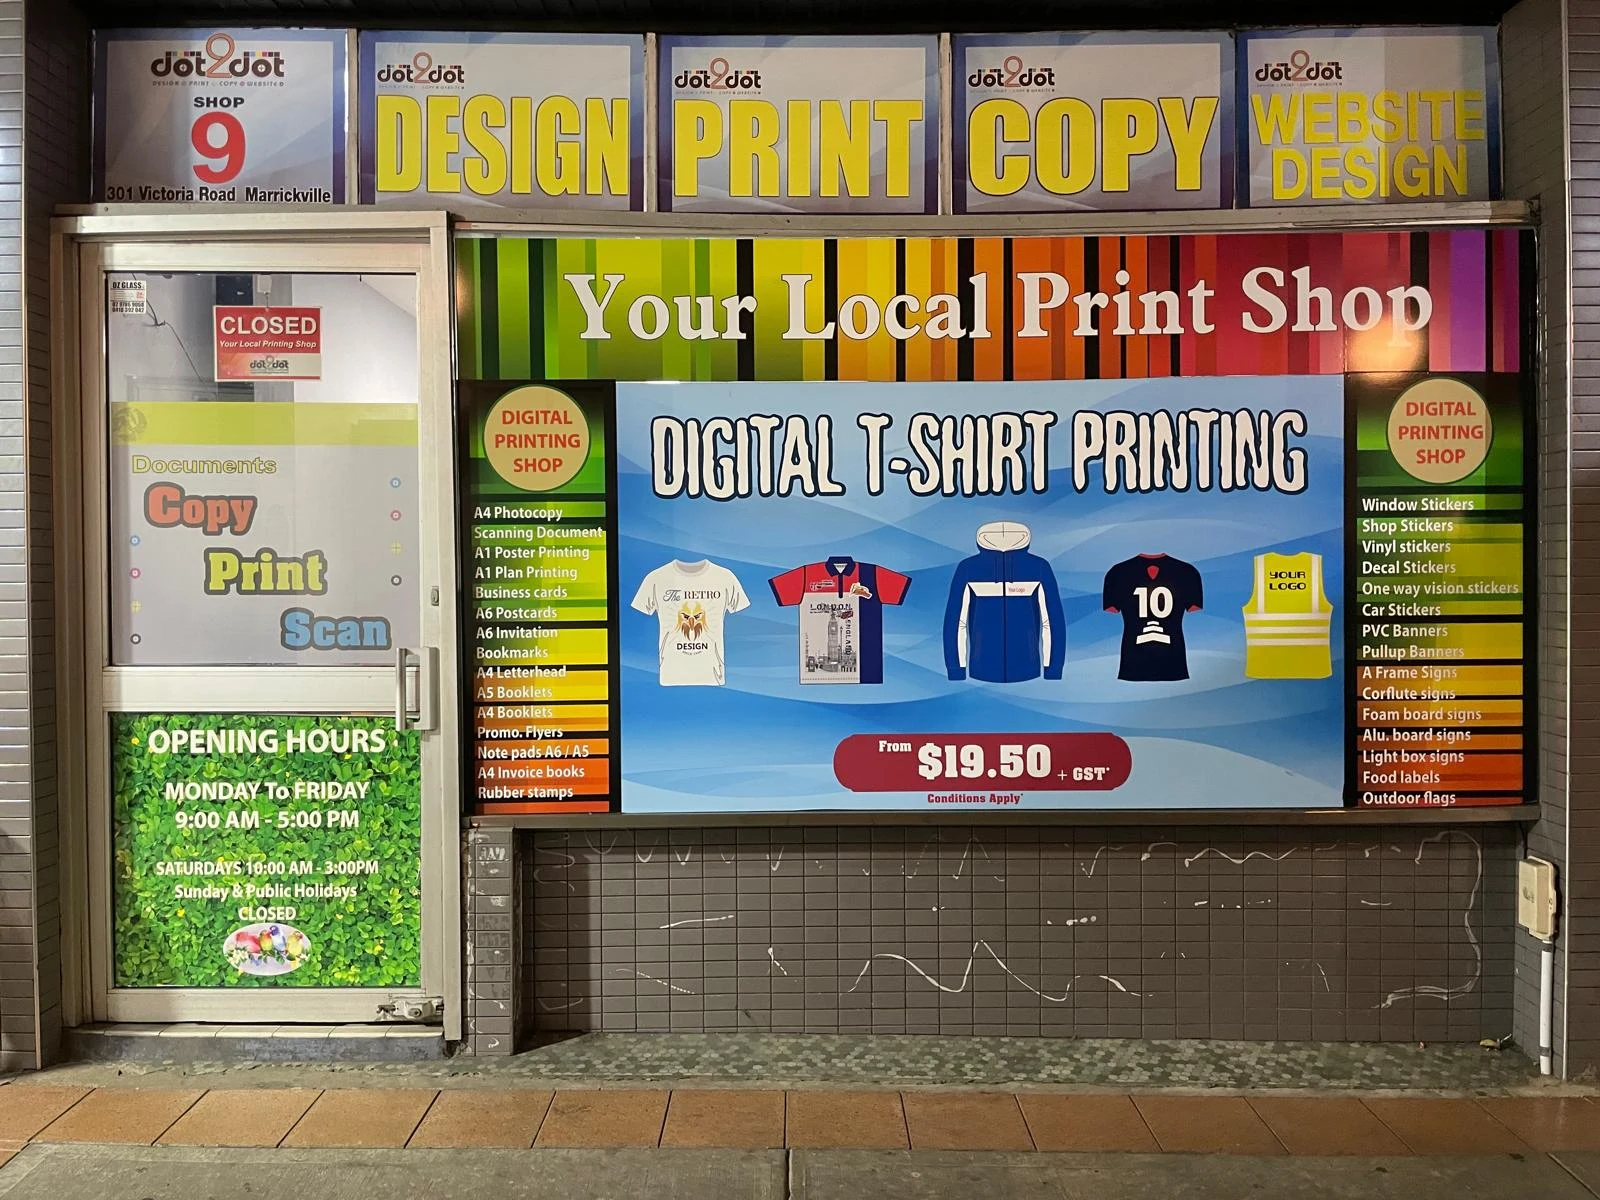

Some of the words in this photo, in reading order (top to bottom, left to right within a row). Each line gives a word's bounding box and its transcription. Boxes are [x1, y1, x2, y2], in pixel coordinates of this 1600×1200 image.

[151, 33, 285, 78] dot2dot
[377, 52, 464, 83] dot2dot
[674, 57, 761, 89] dot2dot
[968, 56, 1055, 87] dot2dot
[1255, 50, 1342, 81] dot2dot
[193, 96, 245, 109] SHOP
[1250, 89, 1485, 145] WEBSITE
[191, 111, 246, 184] 9
[376, 94, 629, 195] DESIGN
[674, 99, 923, 198] PRINT
[968, 97, 1219, 196] COPY
[1272, 143, 1468, 200] DESIGN
[107, 187, 132, 201] 301
[139, 186, 194, 201] Victoria
[199, 187, 236, 202] Road
[245, 187, 332, 203] Marrickville
[563, 273, 758, 341] Your
[780, 272, 992, 341] Local
[1016, 269, 1216, 338] Print
[1241, 265, 1434, 348] Shop
[220, 316, 317, 335] CLOSED
[263, 340, 293, 349] Printing
[296, 341, 316, 349] Shop
[1406, 402, 1476, 416] DIGITAL
[502, 410, 573, 425] DIGITAL
[1398, 425, 1483, 440] PRINTING
[495, 434, 580, 448] PRINTING
[650, 414, 846, 500] DIGITAL
[858, 410, 1057, 497] T-SHIRT
[1072, 408, 1307, 496] PRINTING
[1416, 449, 1465, 464] SHOP
[132, 455, 277, 474] Documents
[513, 458, 563, 473] SHOP
[144, 482, 257, 535] Copy
[1362, 498, 1417, 511] Window
[1421, 498, 1474, 511] Stickers
[474, 507, 491, 519] A4
[494, 506, 562, 521] Photocopy
[474, 527, 533, 541] Scanning
[537, 527, 603, 539] Document
[1362, 519, 1397, 535] Shop
[1401, 519, 1454, 532] Stickers
[475, 547, 490, 559] A1
[495, 547, 535, 559] Poster
[539, 546, 590, 560] Printing
[1362, 540, 1396, 556] Vinyl
[1400, 540, 1451, 553] stickers
[204, 548, 327, 595] Print
[475, 567, 491, 579] A1
[496, 566, 523, 579] Plan
[527, 566, 578, 580] Printing
[1269, 571, 1306, 579] YOUR
[1362, 561, 1399, 574] Decal
[1403, 561, 1456, 574] Stickers
[476, 587, 530, 599] Business
[534, 586, 567, 598] cards
[1269, 582, 1306, 591] LOGO
[1362, 582, 1390, 595] One
[1394, 584, 1420, 597] way
[1424, 582, 1464, 594] vision
[1468, 581, 1518, 594] stickers
[663, 590, 681, 602] The
[684, 590, 720, 600] RETRO
[1133, 586, 1173, 619] 10
[476, 608, 493, 619] A6
[496, 607, 557, 619] Postcards
[1362, 604, 1384, 617] Car
[1388, 603, 1441, 616] Stickers
[281, 607, 391, 650] Scan
[476, 627, 493, 639] A6
[496, 627, 558, 639] Invitation
[1362, 625, 1389, 637] PVC
[1393, 625, 1448, 637] Banners
[477, 647, 548, 659] Bookmarks
[1362, 645, 1405, 661] Pullup
[1410, 645, 1464, 658] Banners
[477, 667, 493, 678] A4
[497, 666, 567, 678] Letterhead
[1363, 667, 1372, 679] A
[1376, 666, 1417, 679] Frame
[1422, 666, 1457, 681] Signs
[477, 687, 493, 699] A5
[497, 686, 552, 699] Booklets
[1363, 687, 1417, 700] Corflute
[1421, 688, 1456, 702] signs
[477, 706, 494, 718] A4
[497, 706, 553, 718] Booklets
[1363, 708, 1399, 721] Foam
[1404, 707, 1443, 721] board
[1447, 709, 1482, 723] signs
[478, 727, 523, 738] Promo.
[525, 726, 563, 740] Flyers
[1363, 728, 1389, 742] Alu.
[1393, 728, 1433, 741] board
[1436, 730, 1471, 744] signs
[149, 729, 278, 754] OPENING
[287, 729, 387, 754] HOURS
[478, 747, 507, 759] Note
[512, 746, 542, 761] pads
[545, 746, 562, 757] A6
[564, 746, 569, 758] /
[573, 745, 589, 757] A5
[879, 740, 912, 752] From
[918, 742, 1051, 780] $19.50
[1057, 769, 1068, 781] +
[1363, 750, 1398, 766] Light
[1401, 750, 1426, 763] box
[1429, 751, 1464, 765] signs
[478, 767, 494, 779] A4
[498, 766, 543, 778] Invoice
[547, 766, 585, 777] books
[1363, 771, 1396, 784] Food
[1401, 771, 1440, 784] labels
[165, 782, 261, 801] MONDAY
[265, 782, 289, 800] To
[295, 782, 370, 800] FRIDAY
[478, 786, 524, 799] Rubber
[528, 787, 573, 800] stamps
[927, 793, 986, 803] Conditions
[1363, 792, 1420, 805] Outdoor
[1424, 791, 1456, 807] flags
[175, 810, 220, 829] 9:00
[225, 810, 260, 829] AM
[277, 810, 321, 829] 5:00
[327, 810, 359, 828] PM
[156, 861, 242, 875] SATURDAYS
[247, 861, 285, 875] 10:00
[288, 861, 314, 875] AM
[324, 860, 379, 875] 3:00PM
[175, 884, 228, 902] Sunday
[232, 883, 243, 899] &
[246, 883, 291, 898] Public
[295, 883, 357, 900] Holidays
[238, 906, 297, 921] CLOSED
